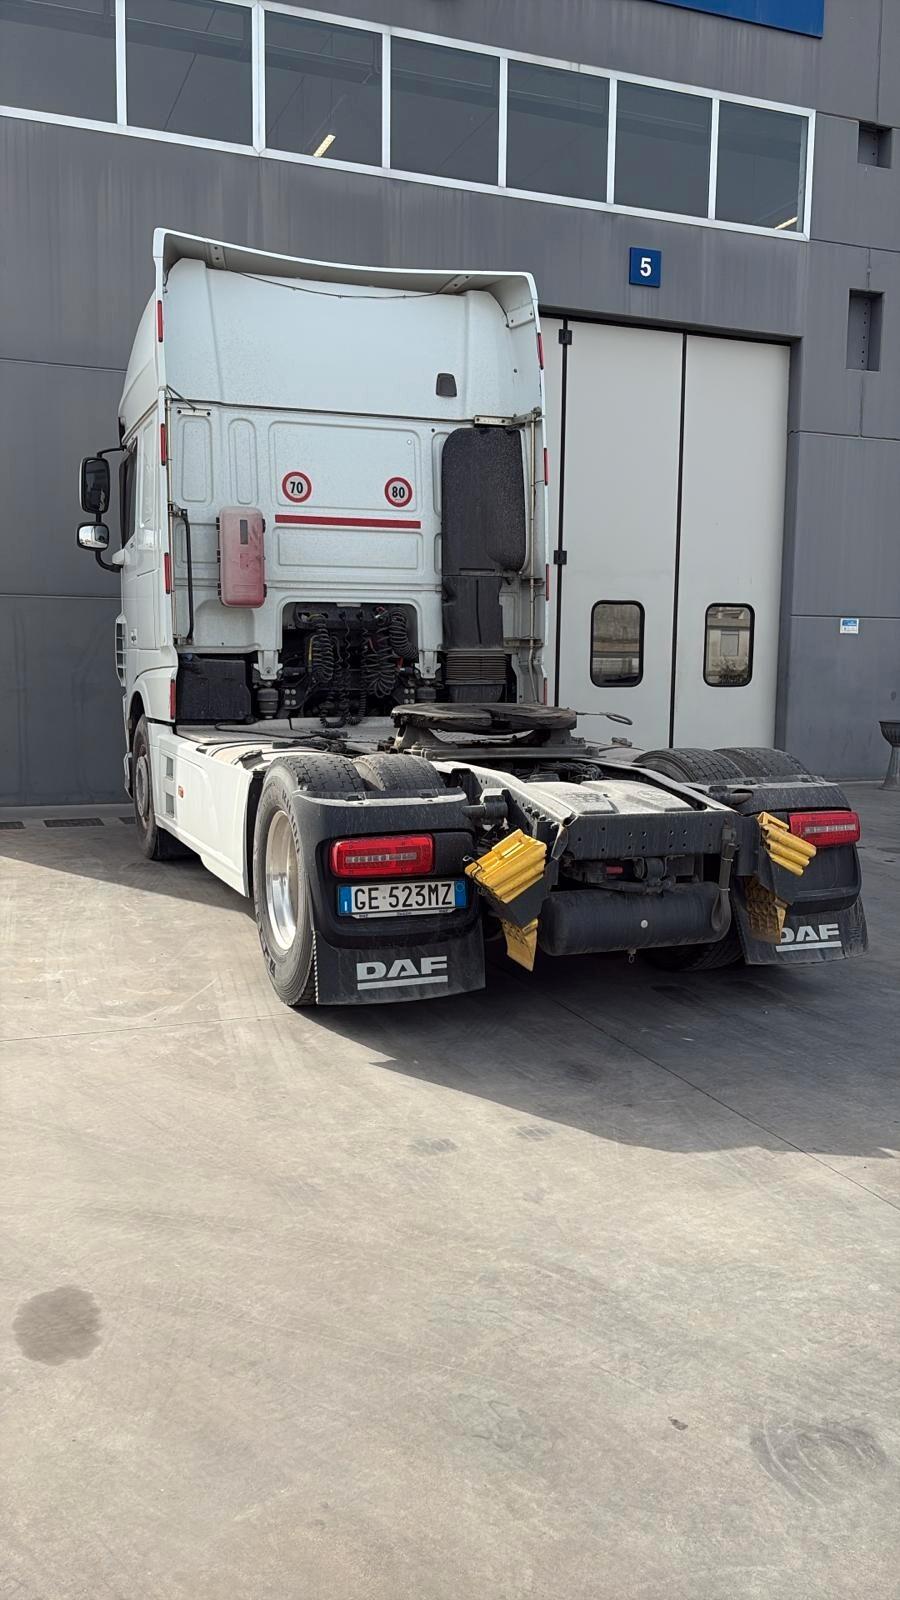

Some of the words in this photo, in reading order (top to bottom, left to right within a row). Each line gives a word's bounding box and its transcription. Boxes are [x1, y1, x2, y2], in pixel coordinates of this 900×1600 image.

[640, 257, 652, 277] 5
[290, 481, 304, 494] 70
[392, 486, 406, 499] 80
[354, 887, 380, 910] GE
[388, 883, 453, 908] 523MZ
[781, 923, 840, 943] DAF
[356, 955, 448, 981] DAF
